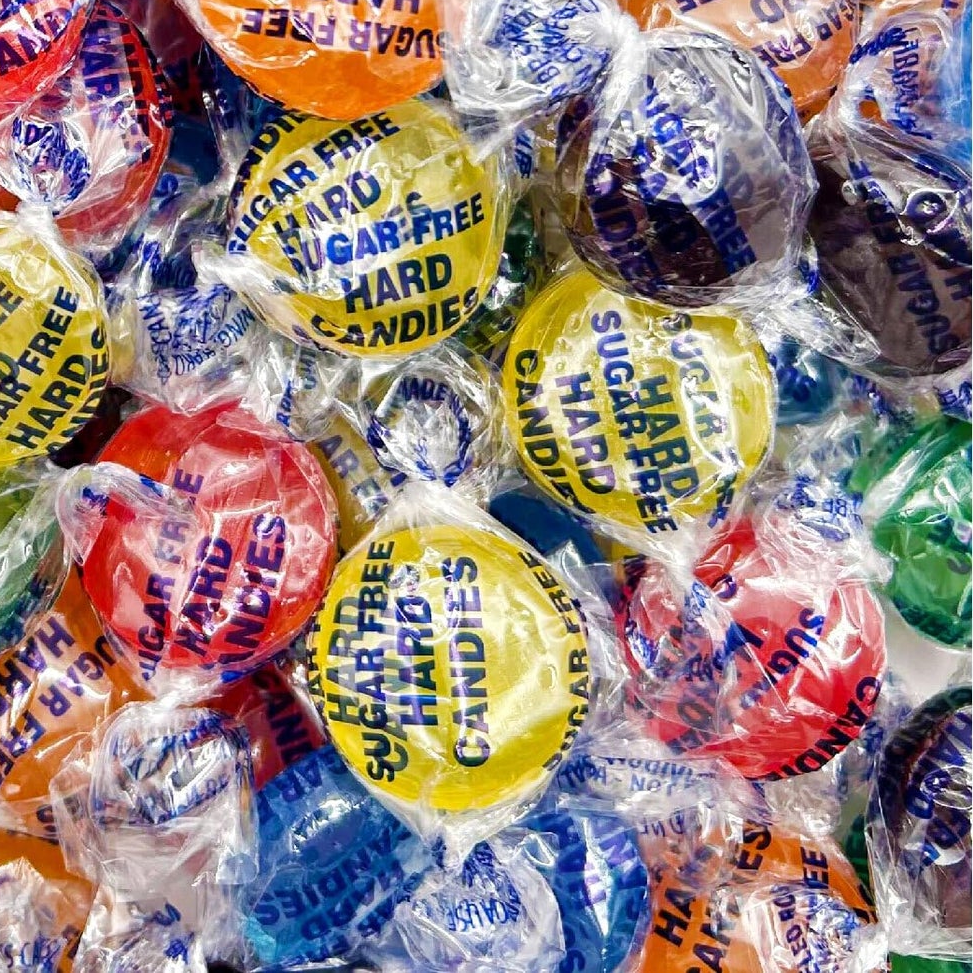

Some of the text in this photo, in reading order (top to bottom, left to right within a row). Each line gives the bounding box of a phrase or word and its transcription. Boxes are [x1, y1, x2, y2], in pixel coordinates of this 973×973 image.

[242, 7, 337, 47] FREE
[313, 112, 401, 169] FREE
[18, 286, 79, 376] FREE
[310, 286, 480, 348] CANDIES
[344, 253, 453, 313] HARD
[6, 354, 91, 449] HARD
[590, 310, 649, 439] SUGAR
[554, 371, 617, 495] HARD
[631, 375, 700, 499] HARD
[38, 634, 117, 719] UGAR
[328, 596, 363, 726] HARD
[355, 541, 396, 783] SUGAR FREE
[395, 595, 439, 727] HARD
[443, 556, 490, 768] CANDIES
[760, 676, 882, 782] CANDI
